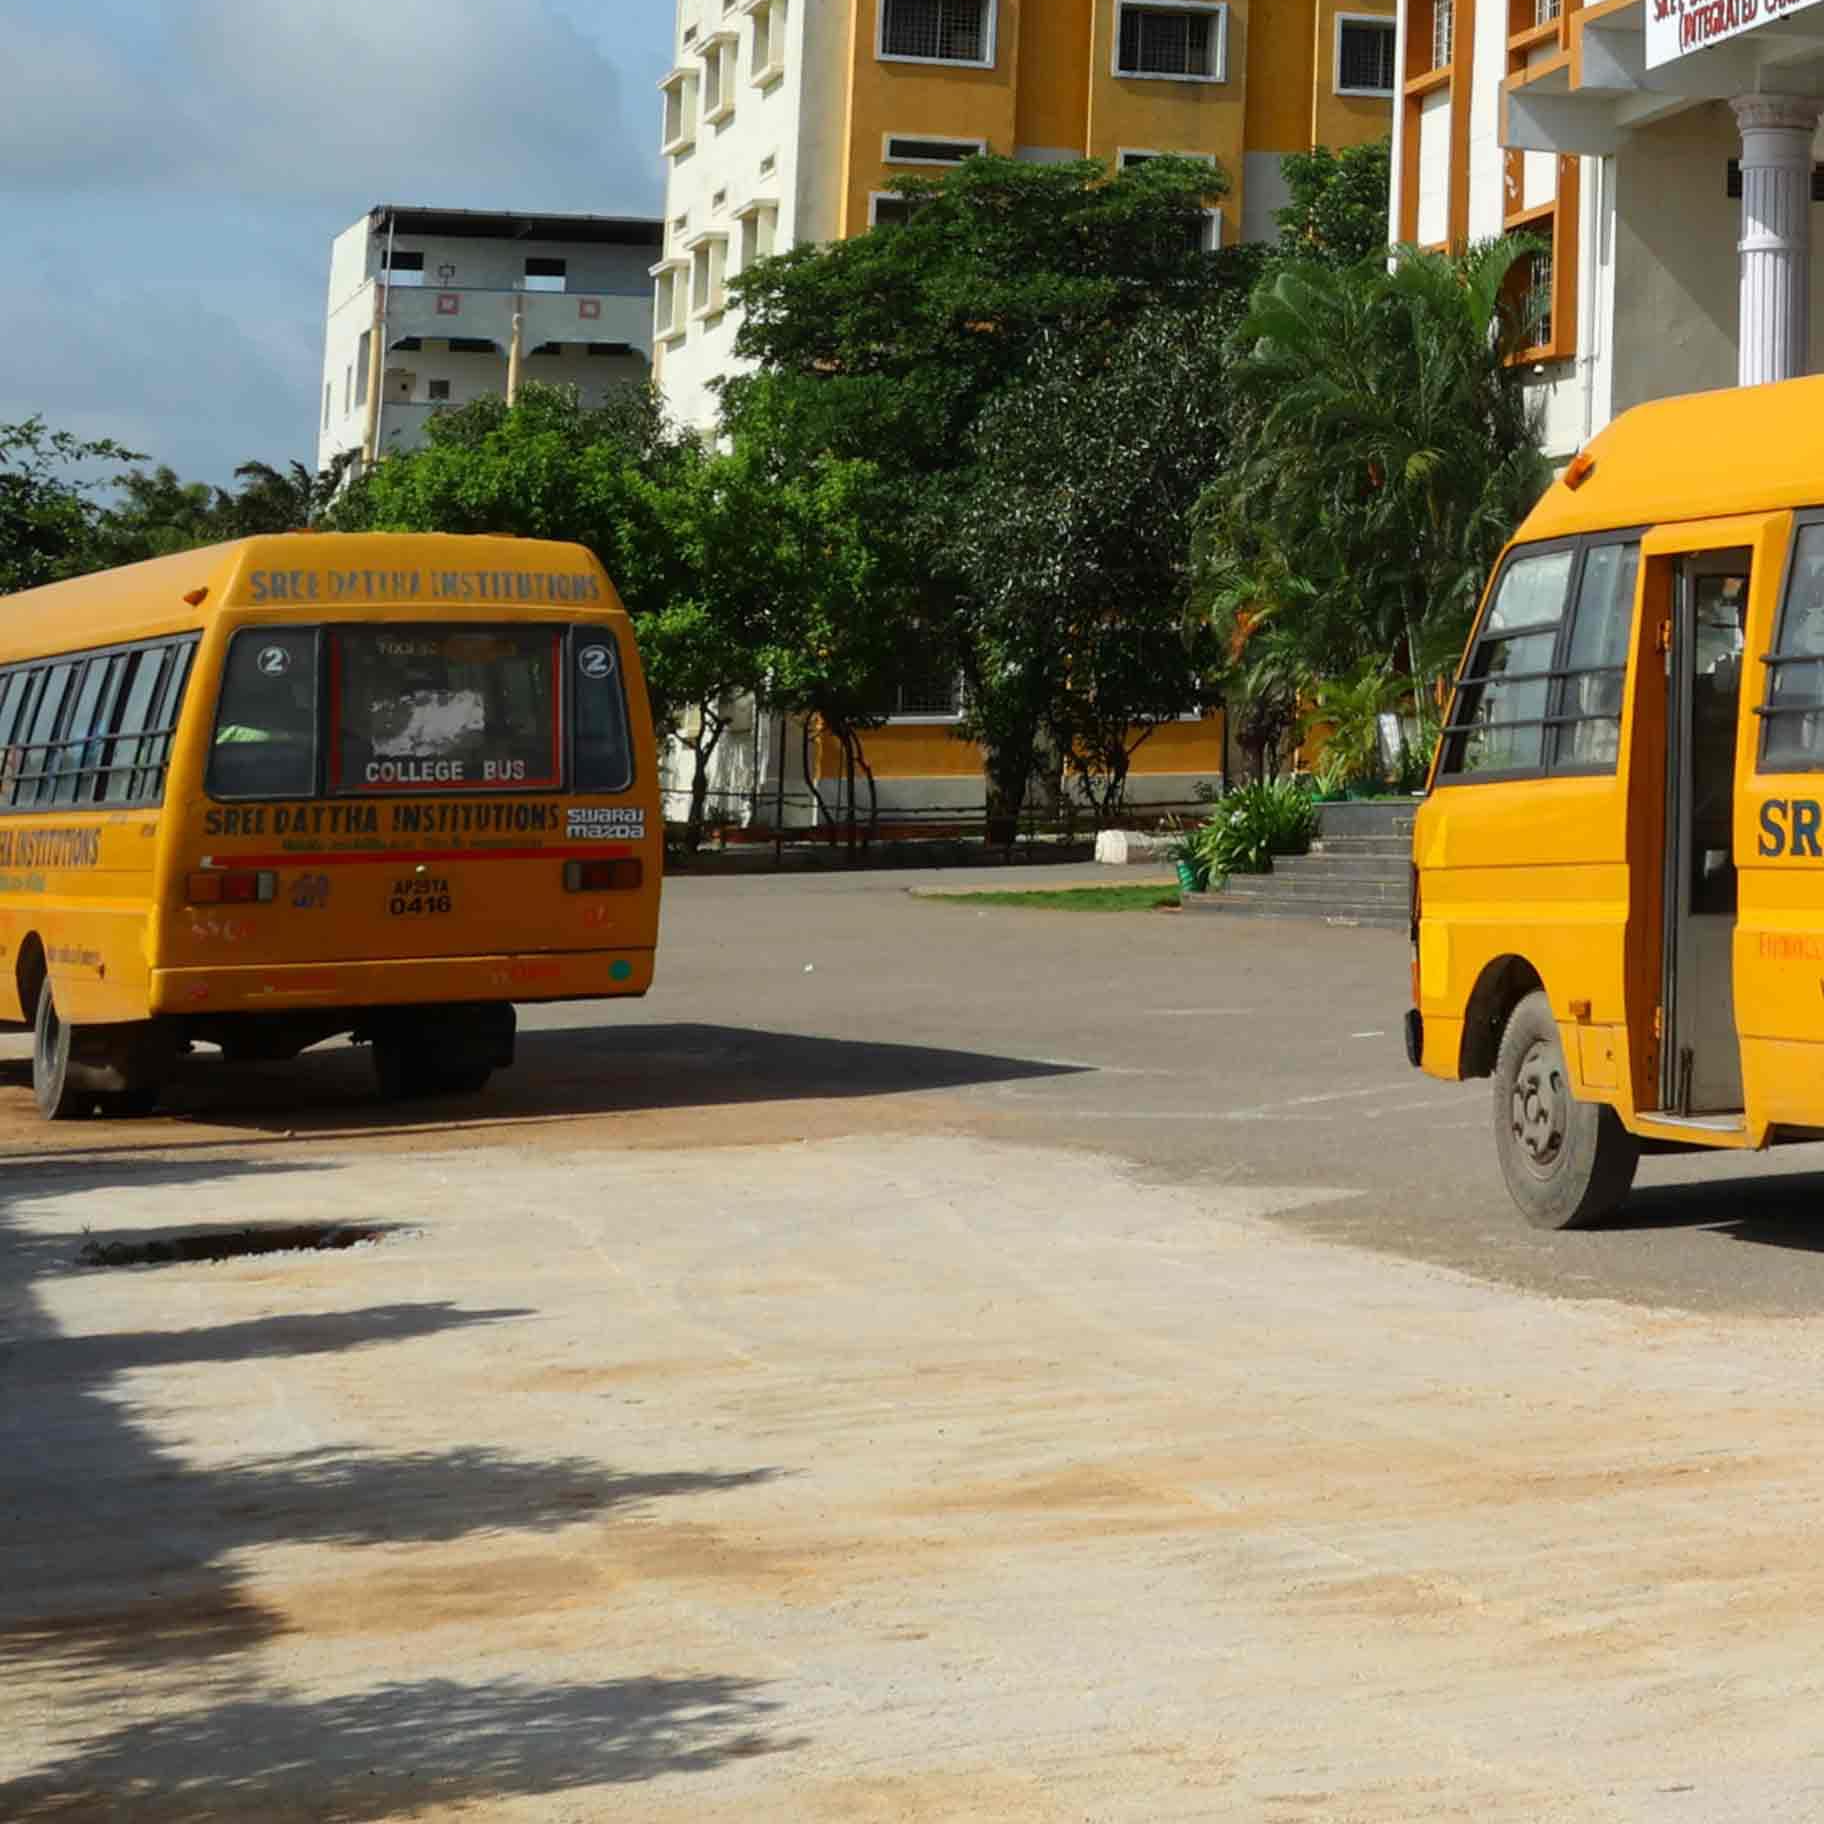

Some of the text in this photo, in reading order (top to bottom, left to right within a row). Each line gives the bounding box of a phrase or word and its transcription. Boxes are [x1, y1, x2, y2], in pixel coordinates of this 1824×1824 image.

[433, 569, 601, 601] INSTITUTIONS
[366, 759, 526, 782] COLLEGE BUS
[206, 803, 560, 836] SREE DATTHA INSTITUTIONS
